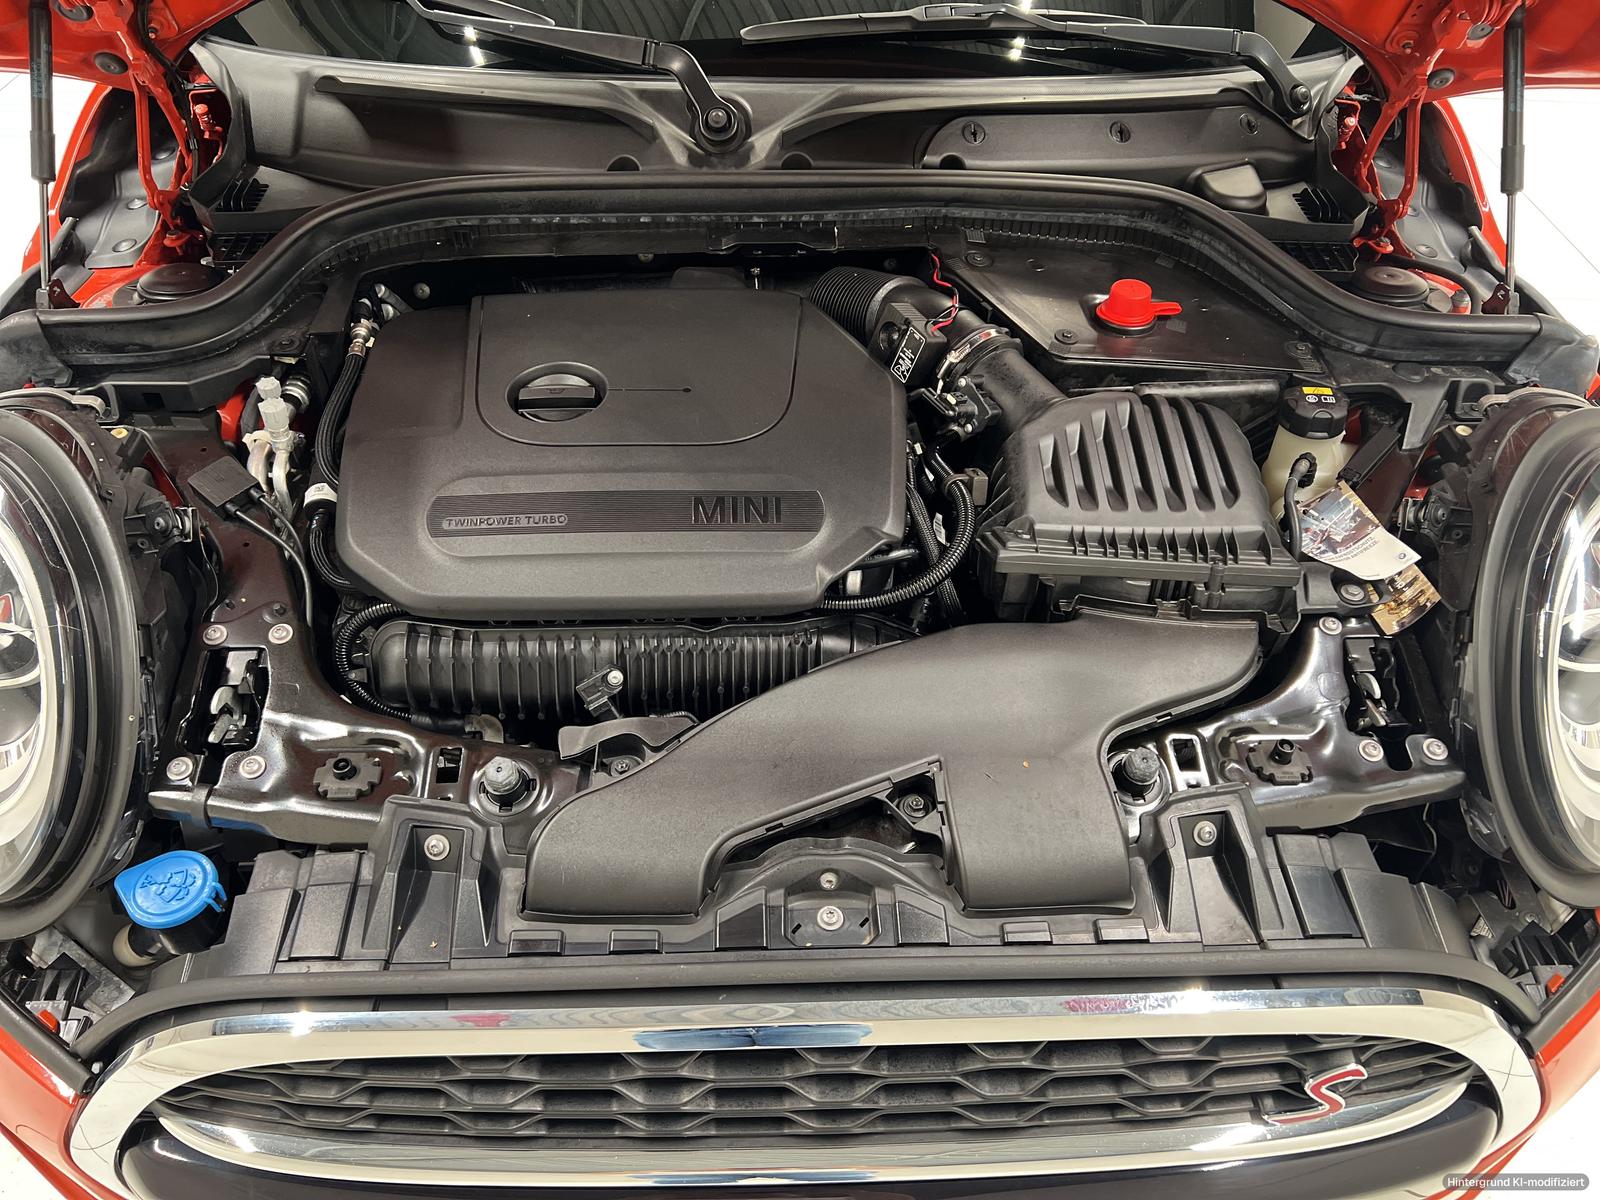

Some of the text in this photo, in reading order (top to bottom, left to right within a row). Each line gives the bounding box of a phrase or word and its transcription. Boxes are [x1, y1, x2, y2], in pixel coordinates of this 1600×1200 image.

[446, 514, 567, 528] TWINPOWER TURBO
[692, 496, 782, 524] MINI
[1262, 1063, 1368, 1126] S
